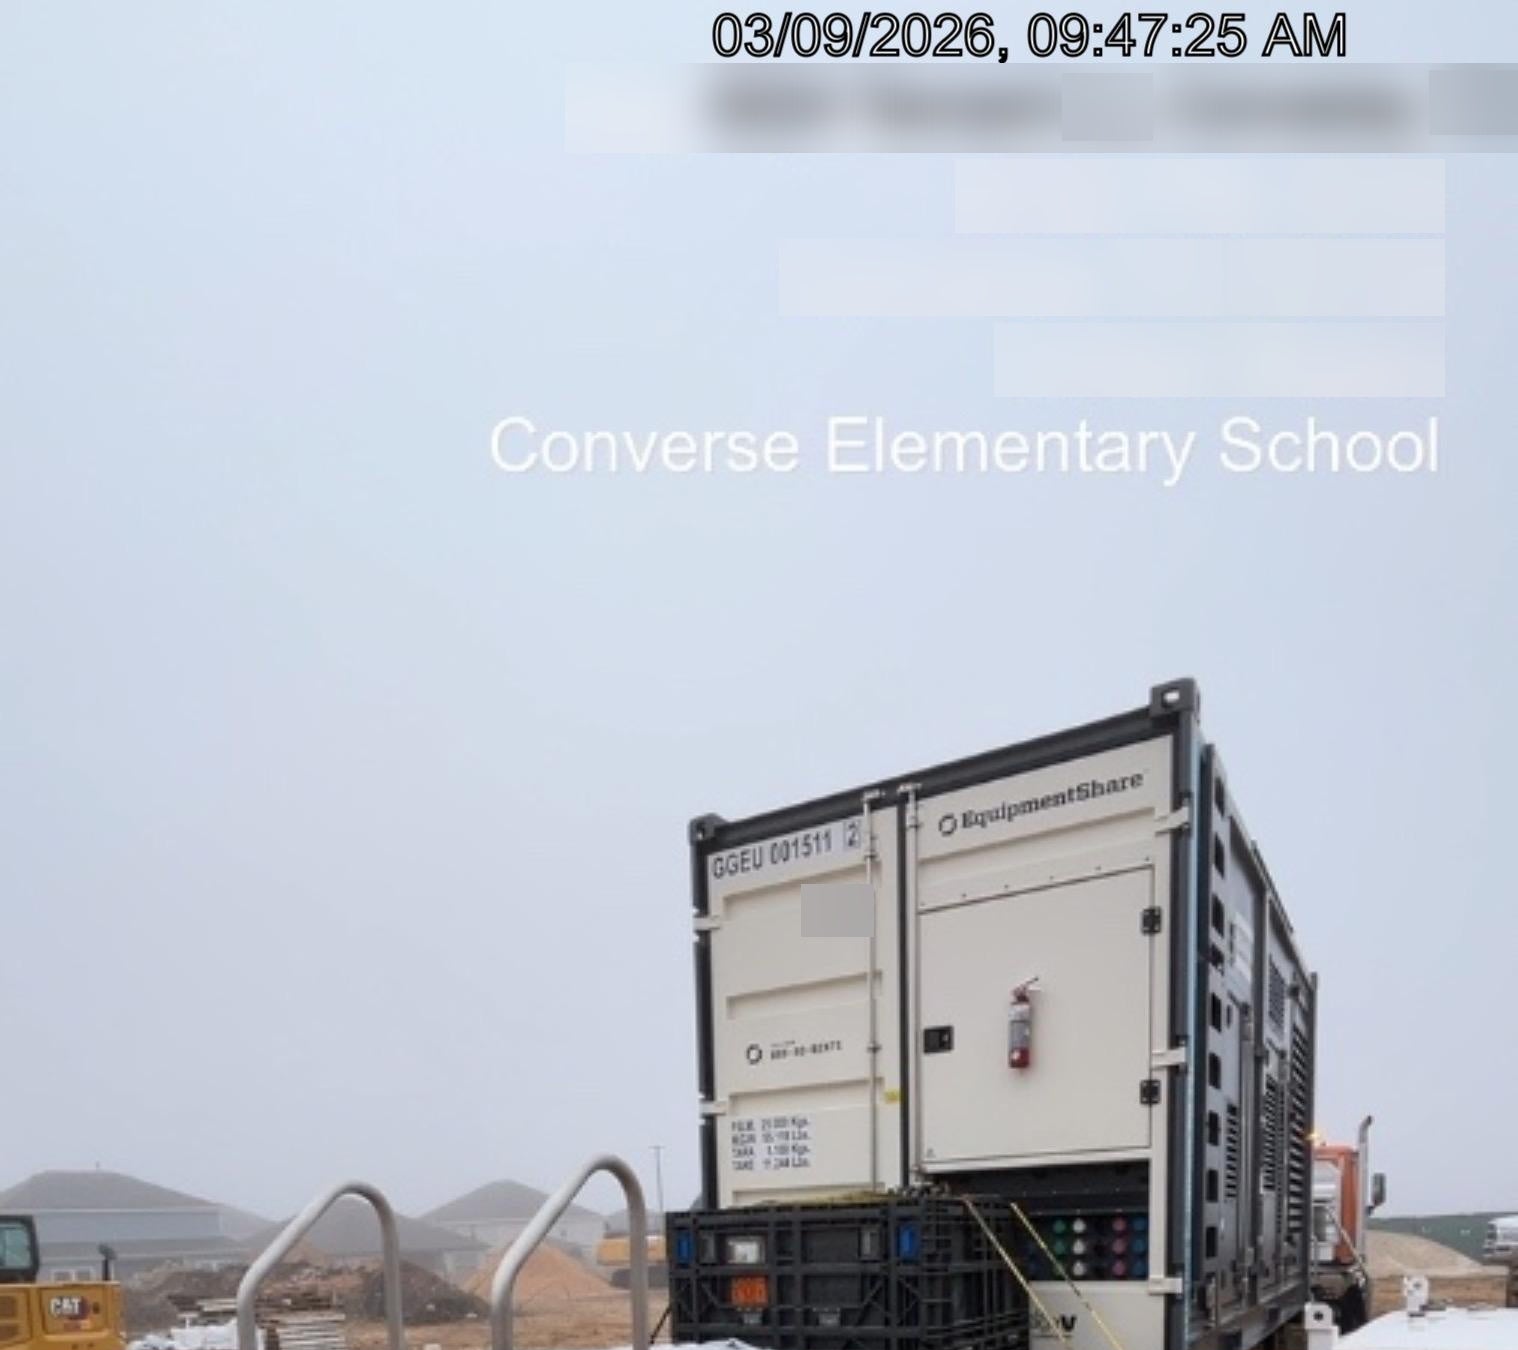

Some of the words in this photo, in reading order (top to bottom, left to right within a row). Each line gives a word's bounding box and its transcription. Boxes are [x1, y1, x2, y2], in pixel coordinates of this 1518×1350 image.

[961, 773, 1144, 829] EquipmentShare
[713, 847, 763, 879] GGEU
[769, 828, 832, 865] 001511
[49, 1296, 81, 1317] CAT
